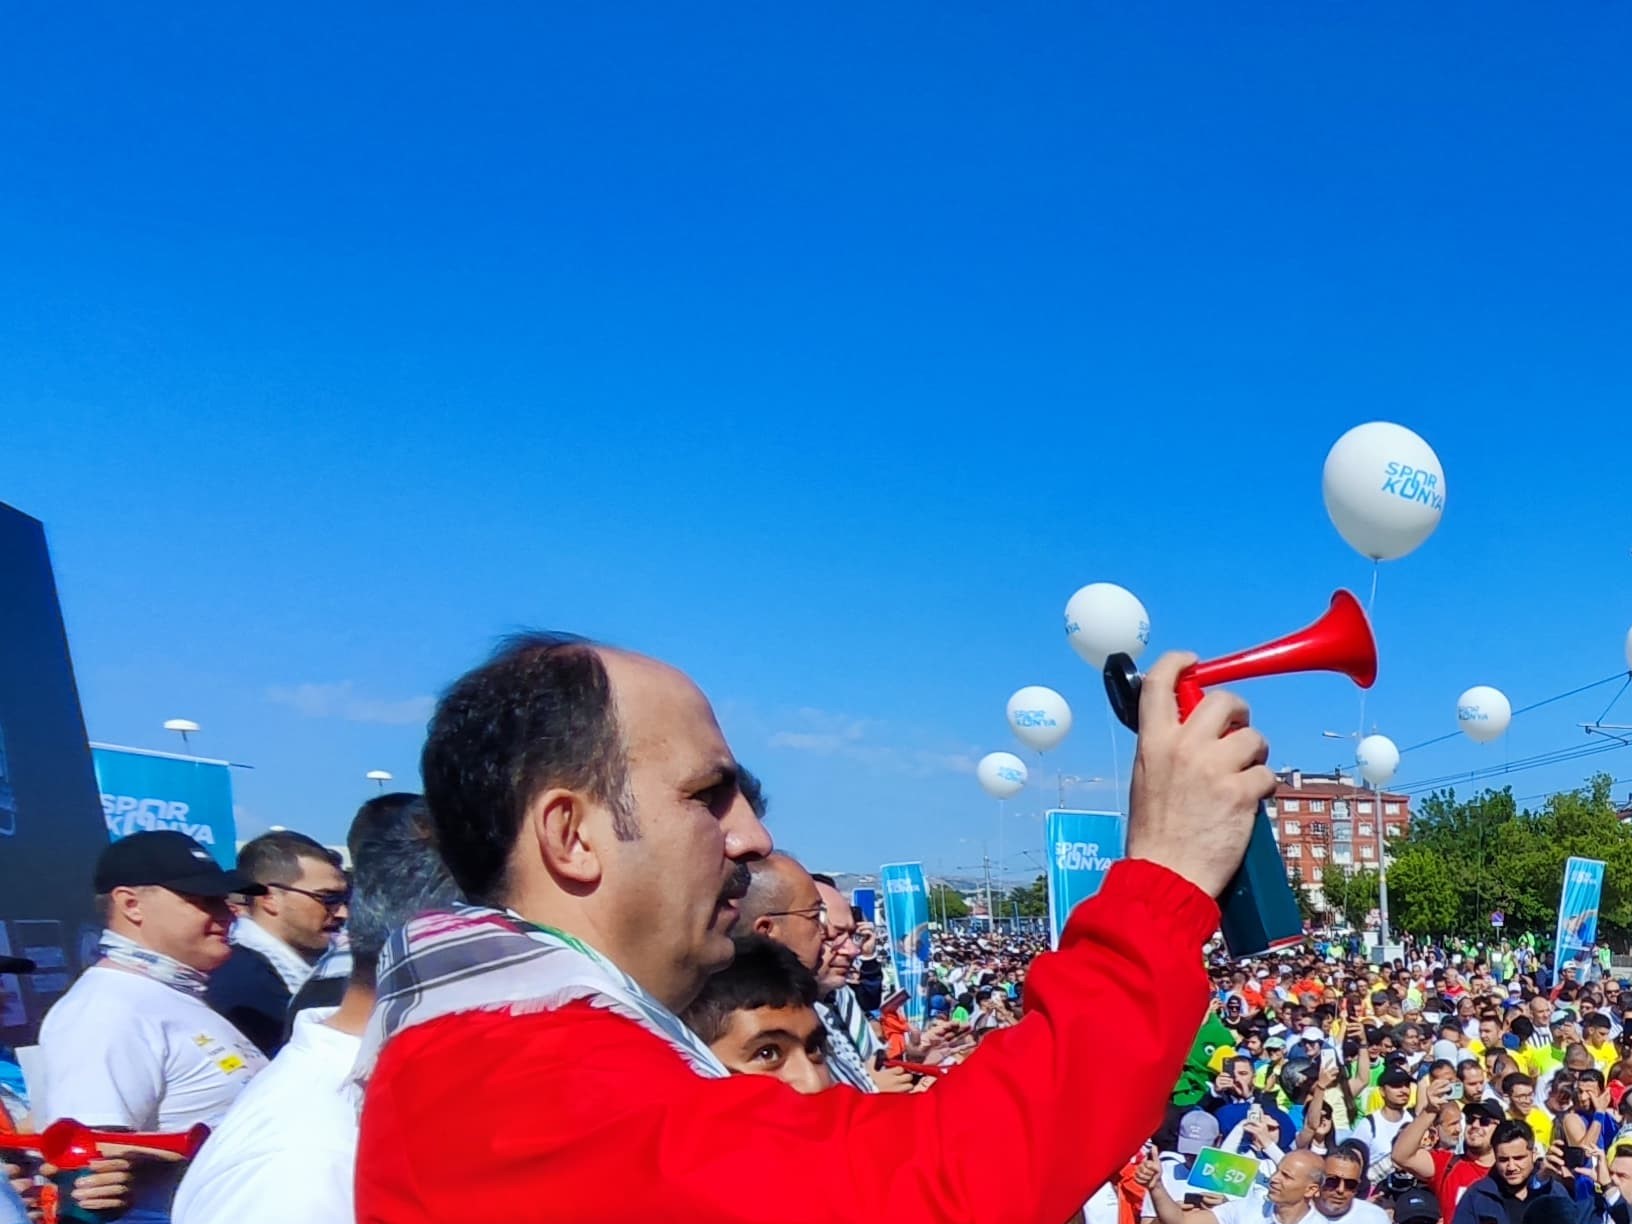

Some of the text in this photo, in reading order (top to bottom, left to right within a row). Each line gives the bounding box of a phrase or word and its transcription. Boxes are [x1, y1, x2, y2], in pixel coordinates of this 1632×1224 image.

[1384, 461, 1438, 489] SPOR
[1382, 477, 1443, 511] KONYA
[101, 794, 190, 822] SPOR
